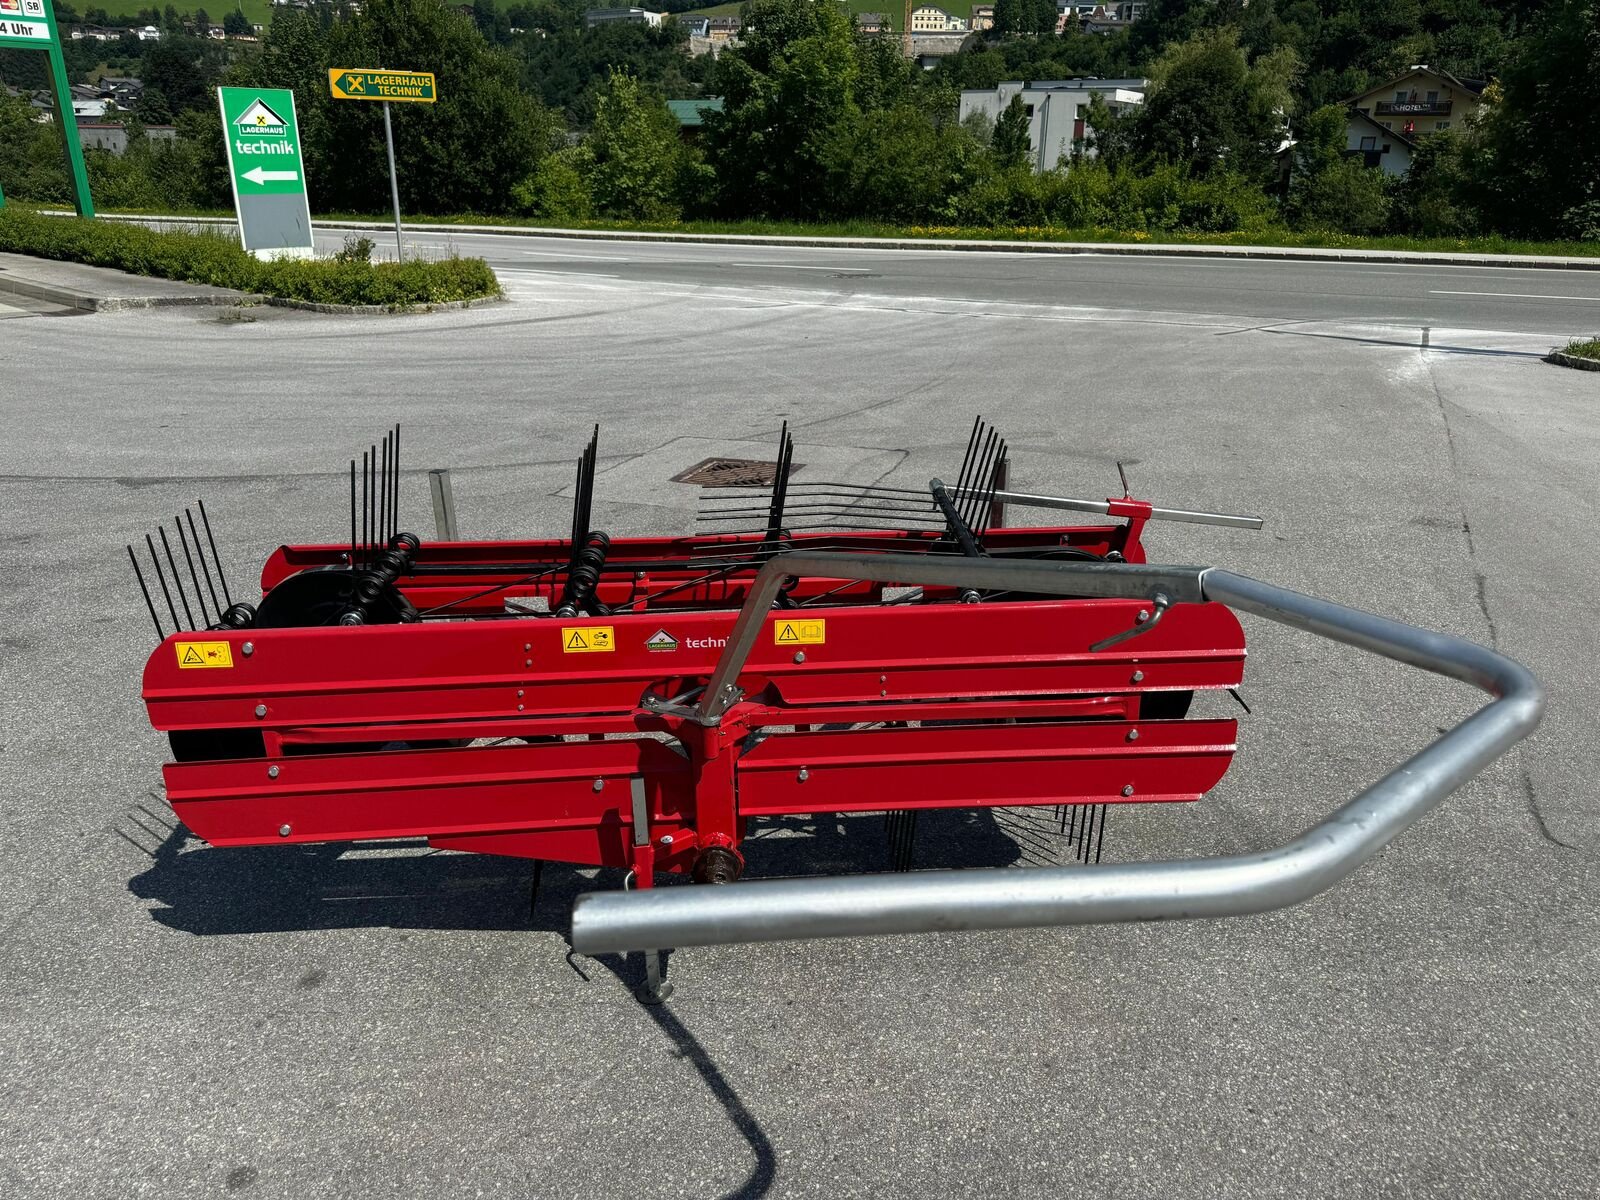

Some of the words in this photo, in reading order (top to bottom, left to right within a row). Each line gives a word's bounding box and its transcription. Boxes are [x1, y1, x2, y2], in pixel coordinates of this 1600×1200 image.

[26, 1, 39, 11] SB
[11, 23, 33, 36] Uhr
[367, 75, 431, 87] LAGERHAUS
[377, 85, 423, 96] TECHNIK
[241, 126, 284, 134] LAGERHAUS
[235, 139, 294, 154] technik
[685, 636, 729, 648] techn
